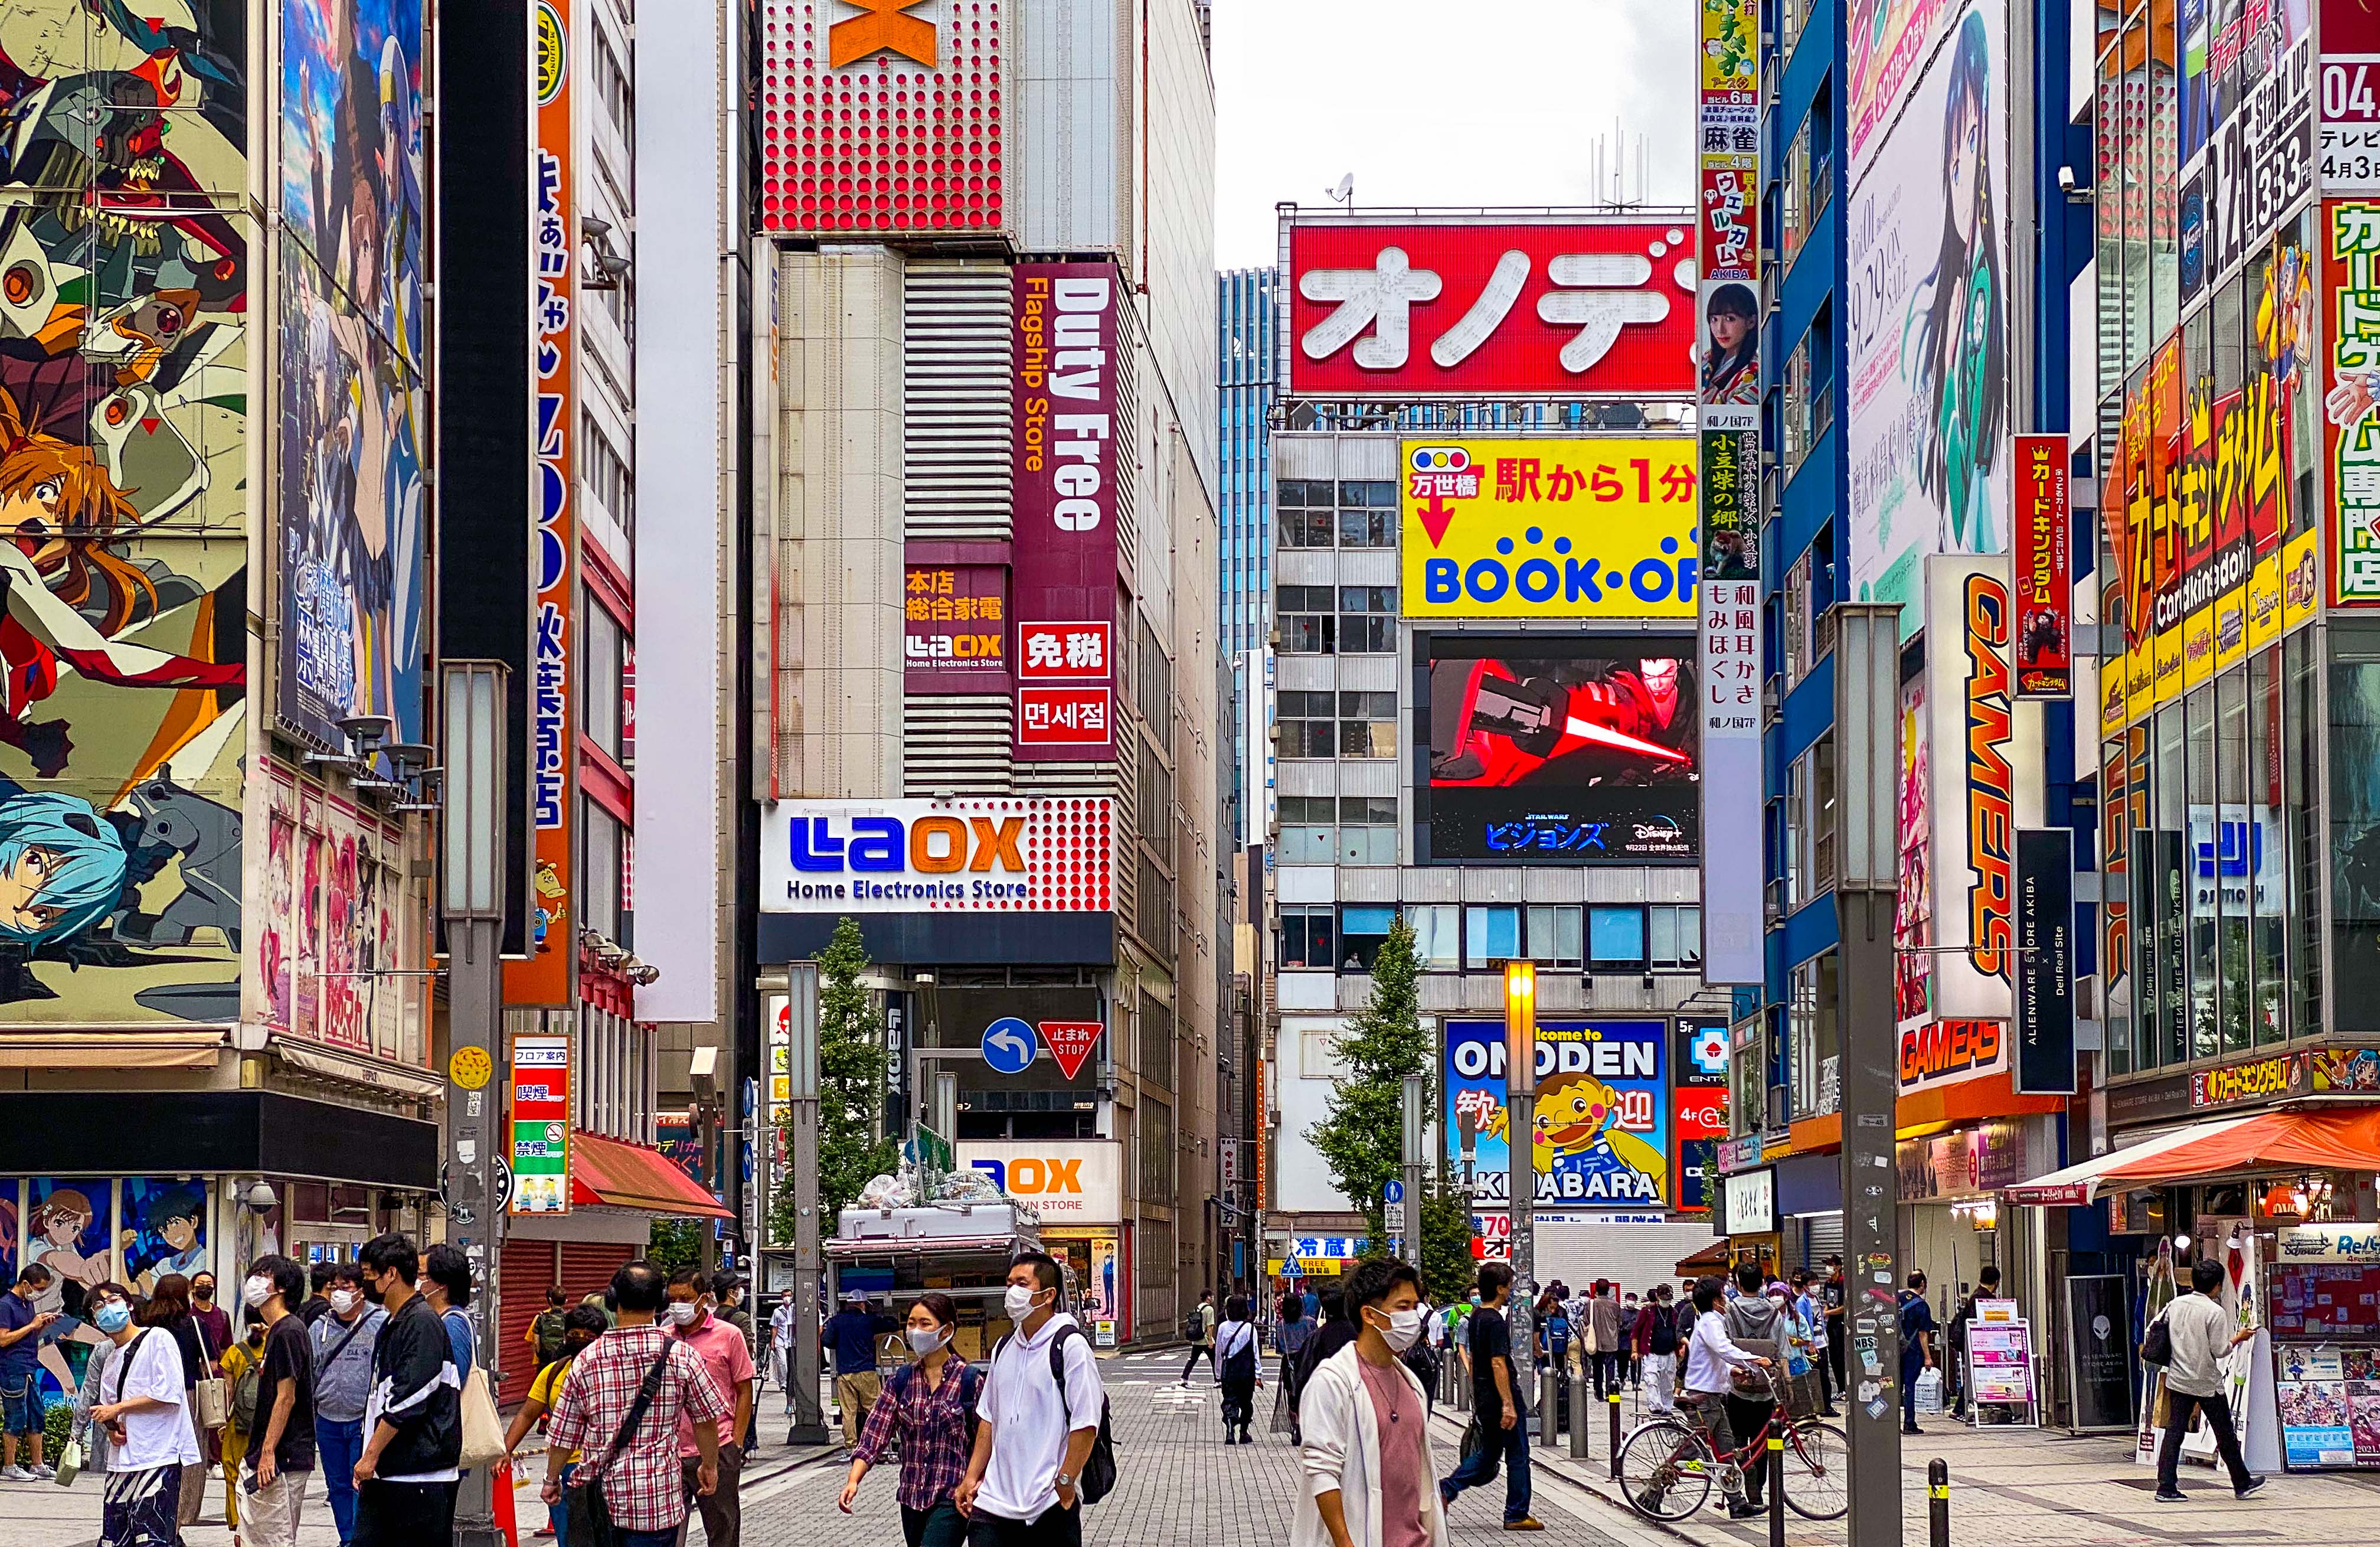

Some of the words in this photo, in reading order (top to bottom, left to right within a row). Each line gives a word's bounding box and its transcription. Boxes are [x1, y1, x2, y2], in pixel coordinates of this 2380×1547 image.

[1704, 125, 1755, 150] 麻雀
[1711, 269, 1749, 279] AKIBA
[1299, 227, 1696, 373] オノデ
[1020, 277, 1048, 388] Flagship
[1048, 278, 1110, 401] Duty
[2339, 210, 2380, 592] カードゲム専門店
[1025, 397, 1048, 472] Store
[1053, 414, 1110, 531] Free
[1710, 434, 1738, 529] 小豆柴の郷
[1411, 474, 1478, 497] 万世橋
[2032, 463, 2051, 604] カードキングダム
[905, 570, 955, 595] 本店
[905, 596, 1003, 621] 総合家電
[1026, 632, 1103, 668] 免税
[1708, 585, 1729, 704] もみほぐし
[1735, 585, 1755, 704] 和風耳かき
[906, 659, 930, 667] Home
[932, 659, 979, 667] Electronics
[980, 658, 1003, 667] Store
[1025, 701, 1104, 730] 면세점
[1486, 821, 1610, 851] ビジョンズ
[787, 880, 845, 899] Home
[853, 880, 964, 899] Electronics
[972, 880, 1027, 899] Store
[2026, 876, 2035, 916] AKIBA
[2026, 922, 2036, 963] STORE
[2055, 925, 2064, 949] Site
[2055, 952, 2064, 974] Real
[2055, 975, 2064, 996] Dell
[2028, 968, 2036, 1046] ALIENWARE
[1052, 1029, 1090, 1042] 止まれ
[1584, 1027, 1602, 1041] to
[1679, 1021, 1694, 1033] 5F
[515, 1051, 565, 1061] フロア案内
[1058, 1044, 1085, 1055] STOP
[516, 1086, 548, 1101] 喫煙
[1680, 1107, 1698, 1121] 4F
[515, 1141, 547, 1156] 禁煙
[1458, 1173, 1658, 1199] AKIABARA
[1042, 1200, 1083, 1210] STORE
[1854, 1338, 1874, 1348] NBS
